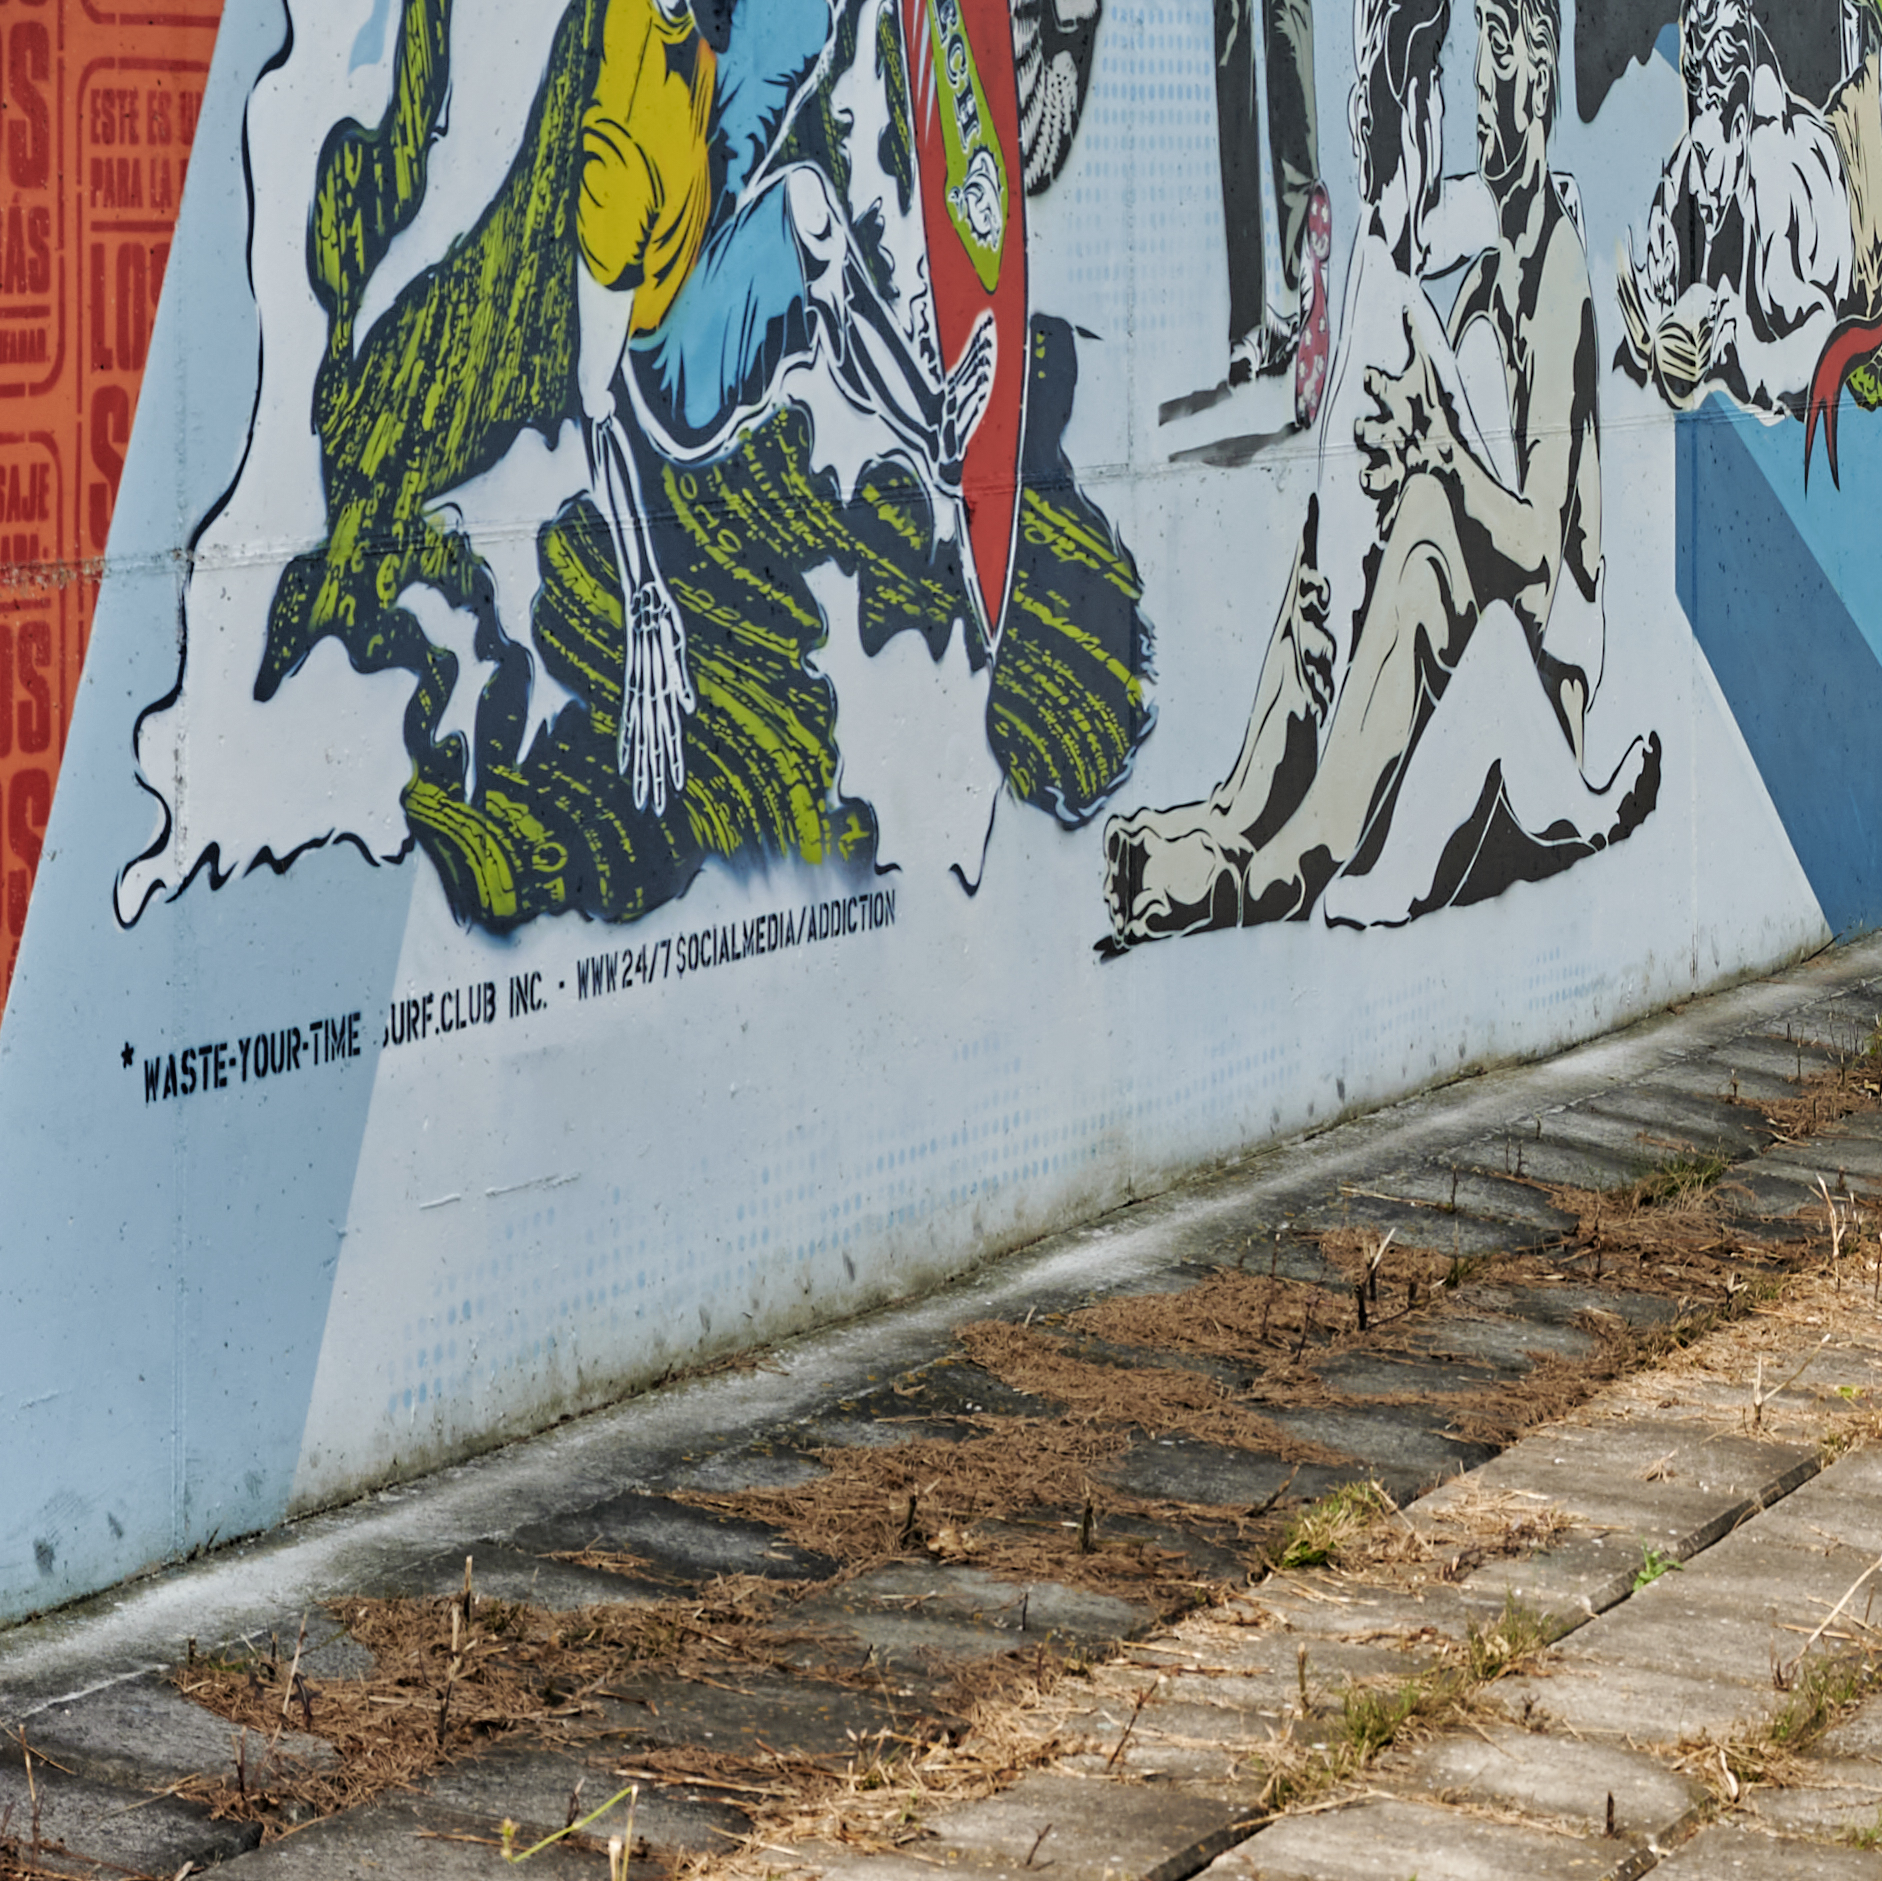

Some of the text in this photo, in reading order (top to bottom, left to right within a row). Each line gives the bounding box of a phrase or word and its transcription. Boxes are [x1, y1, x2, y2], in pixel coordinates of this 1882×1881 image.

[89, 88, 140, 146] ESTE
[146, 89, 173, 146] ES
[89, 157, 173, 209] PARA LA
[143, 1011, 361, 1105] WASTE-YOUR-TIME
[508, 970, 548, 1018] INC.
